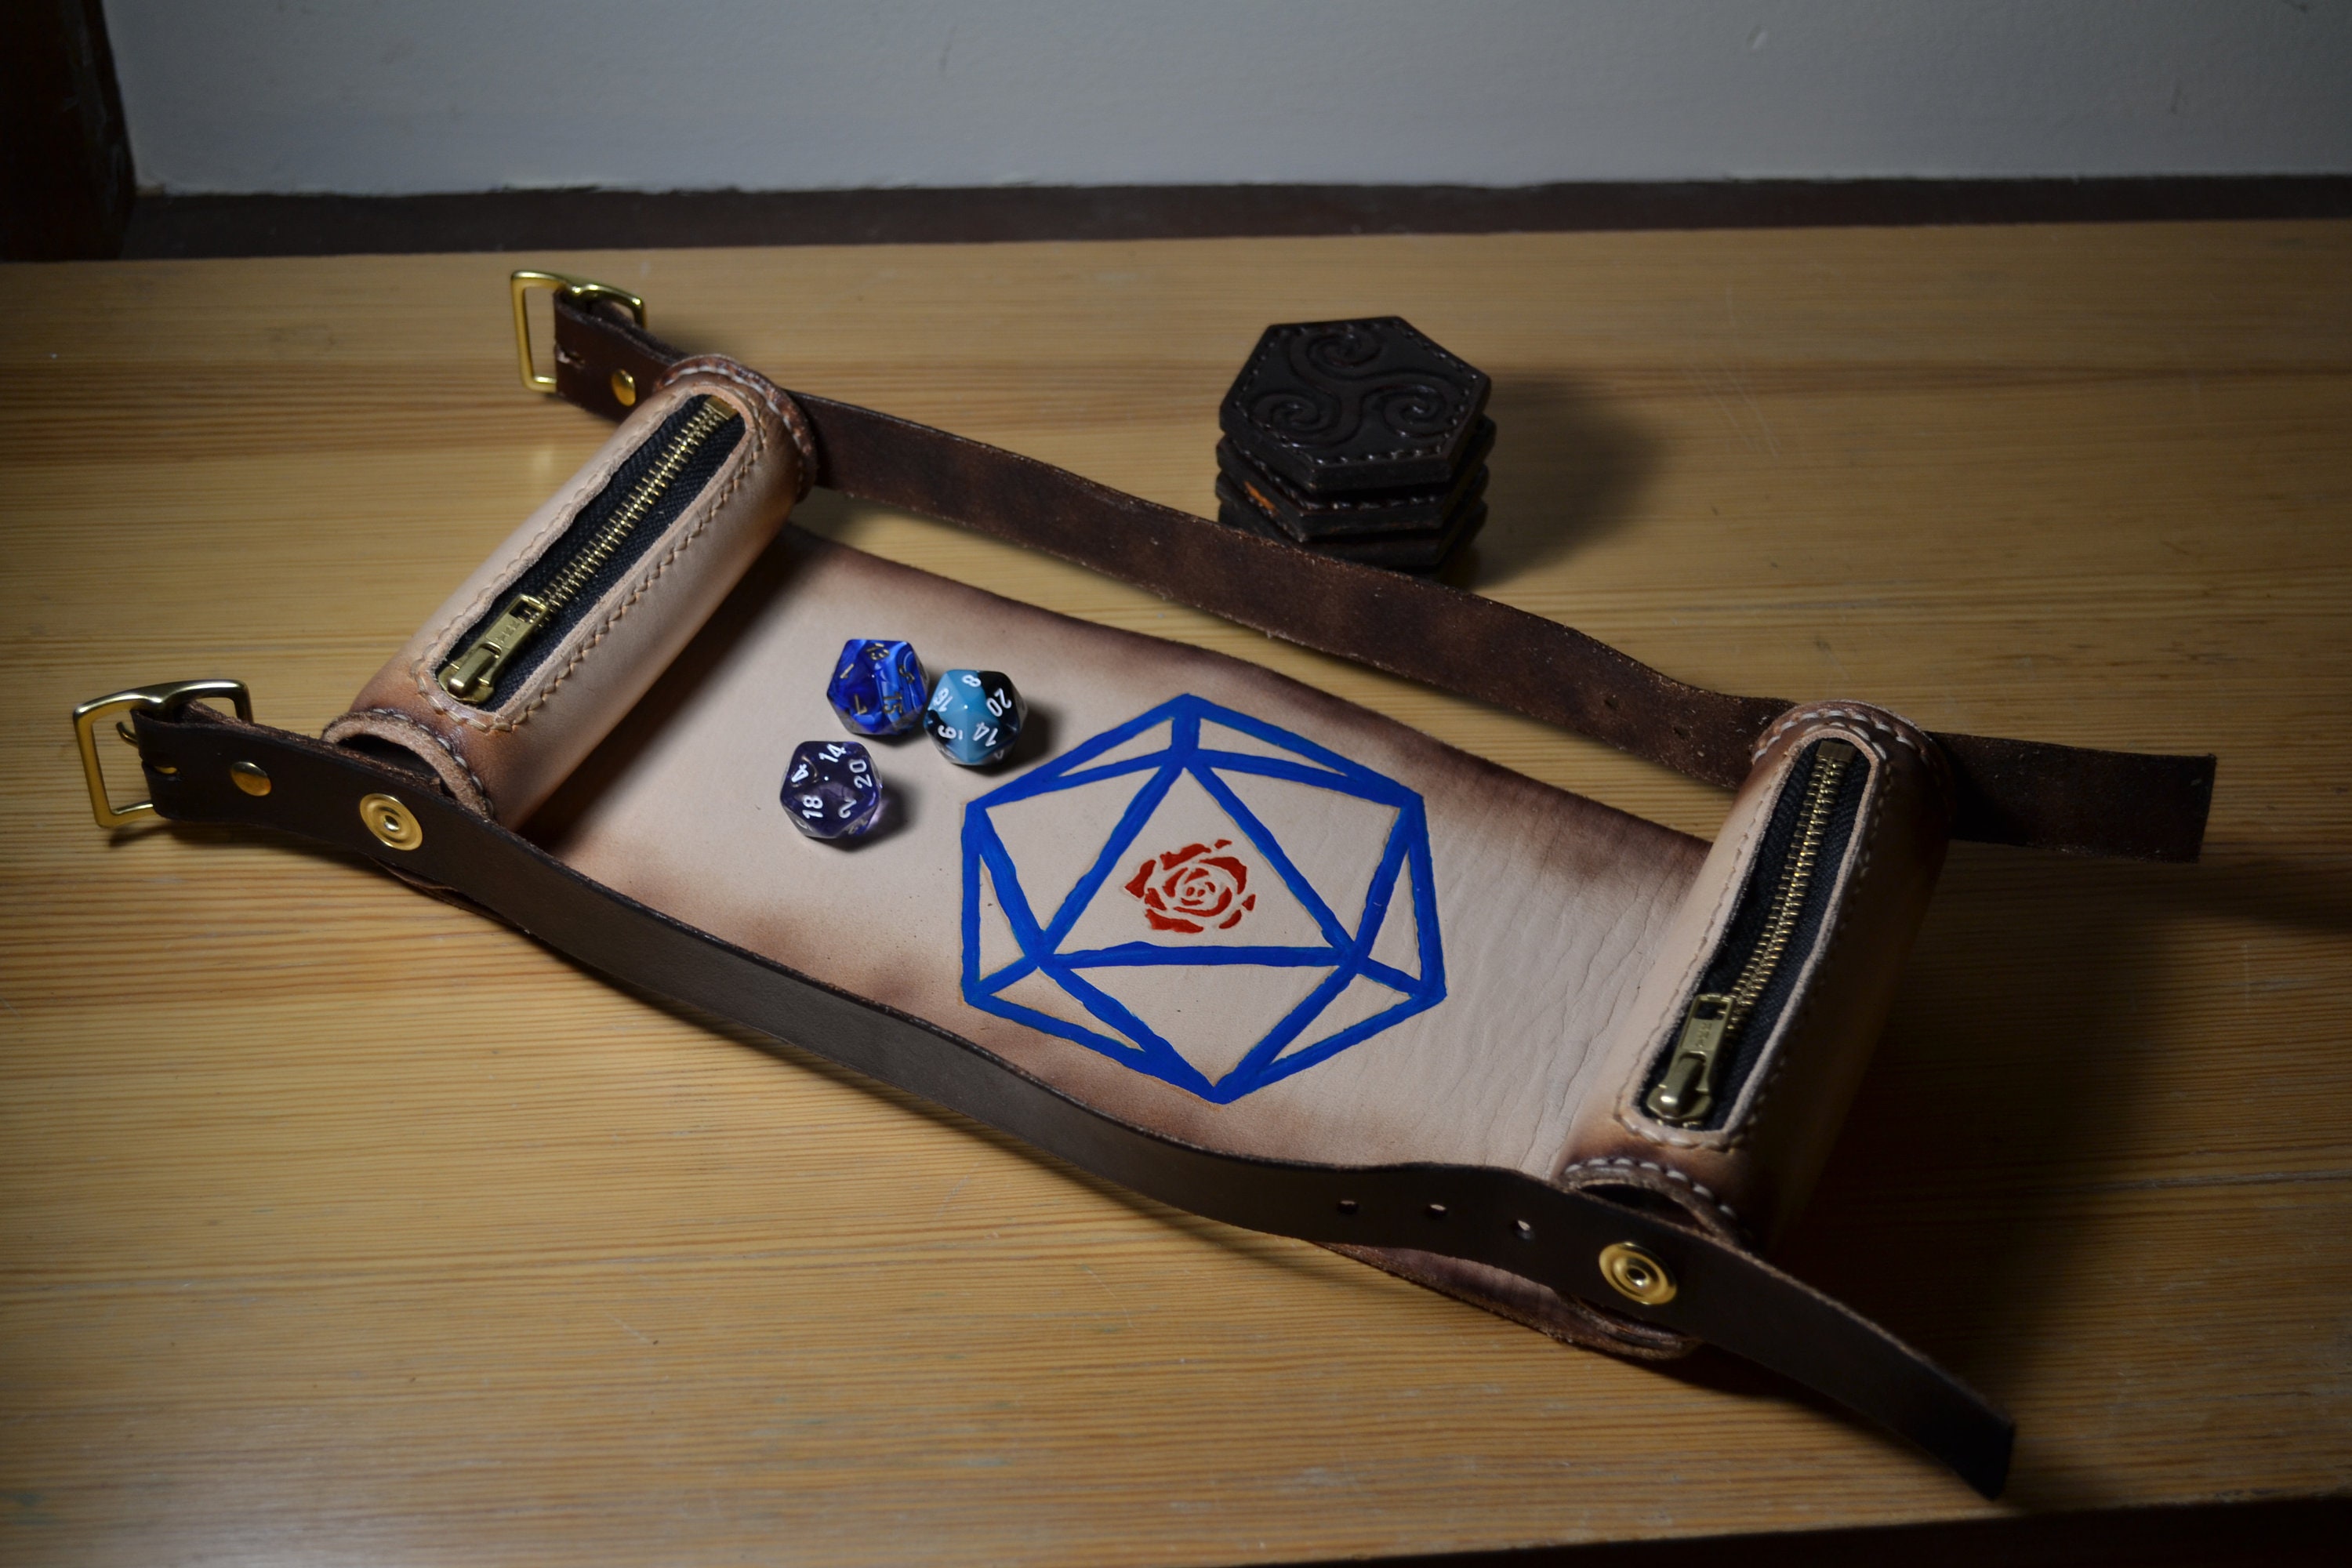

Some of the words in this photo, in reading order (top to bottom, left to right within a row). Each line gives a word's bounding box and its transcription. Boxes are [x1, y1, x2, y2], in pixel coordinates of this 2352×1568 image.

[962, 674, 982, 687] 8
[883, 691, 902, 714] 15
[986, 688, 1012, 717] 20
[972, 722, 998, 746] 14
[818, 743, 847, 763] 14
[791, 764, 809, 782] 4
[849, 759, 873, 789] 20
[802, 795, 823, 818] 18
[839, 797, 857, 818] 2
